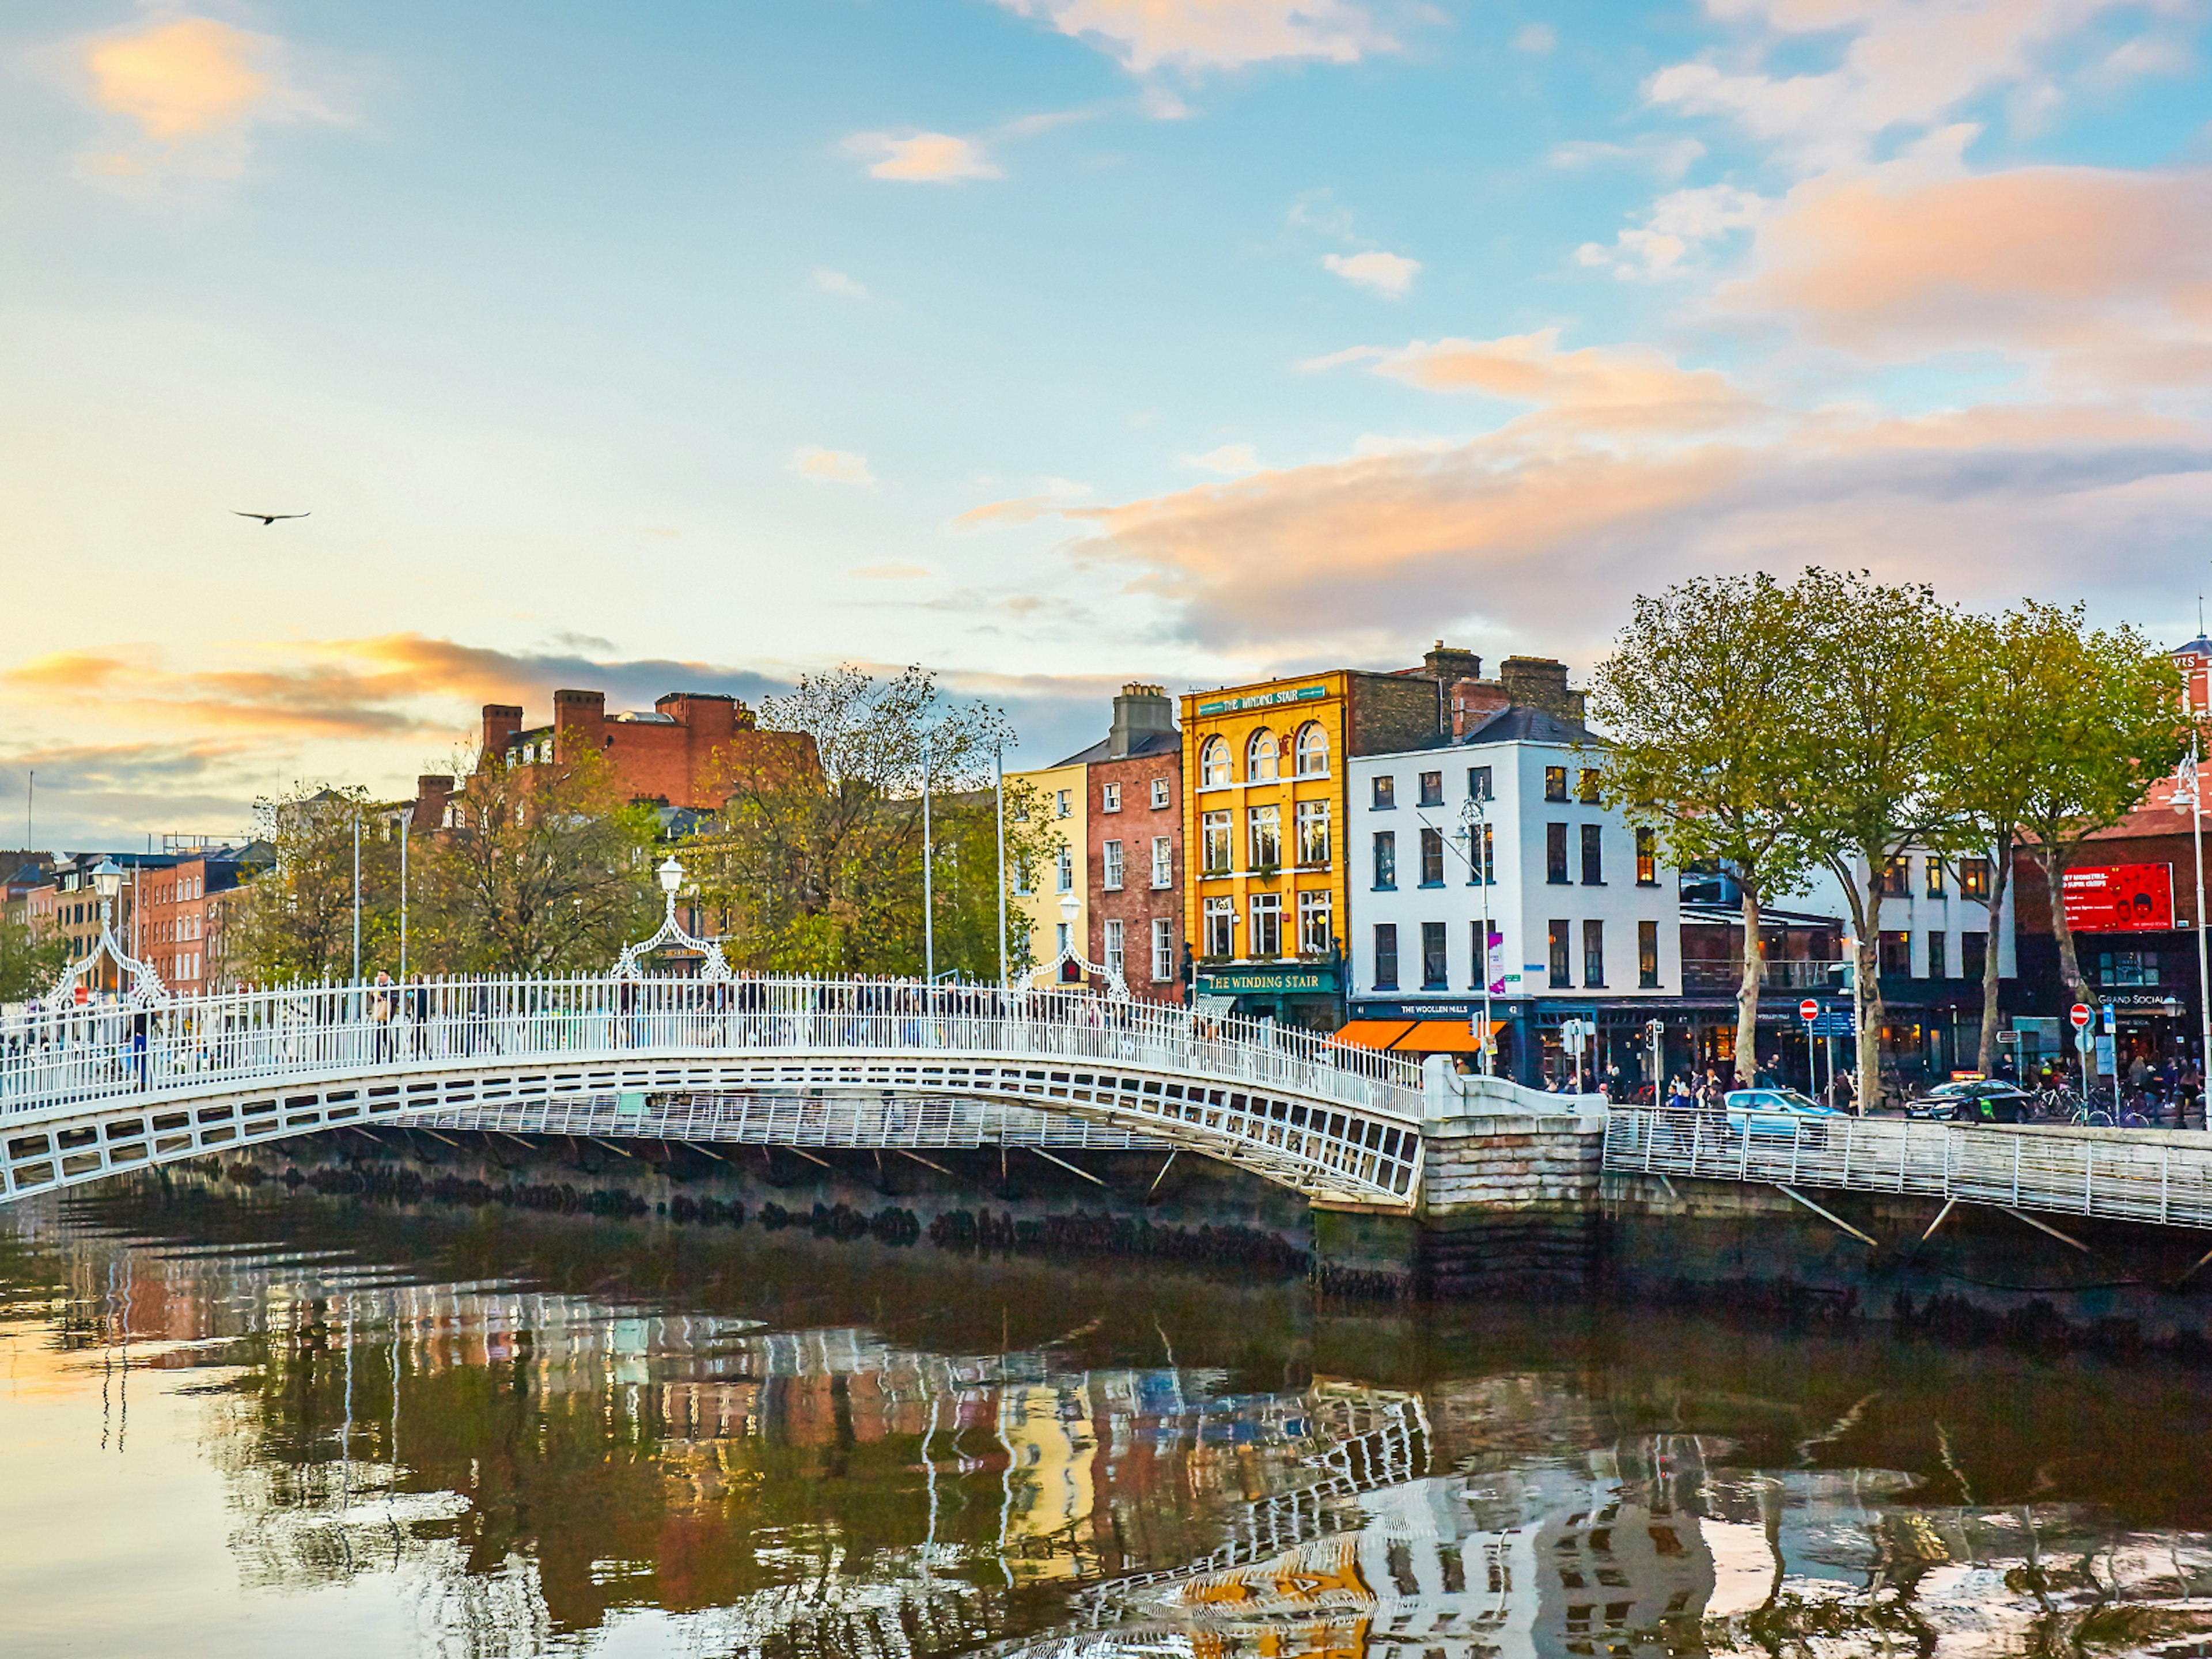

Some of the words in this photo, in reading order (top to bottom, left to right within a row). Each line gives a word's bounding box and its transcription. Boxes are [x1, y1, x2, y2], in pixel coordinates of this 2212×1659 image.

[1224, 699, 1238, 711] THE
[1242, 694, 1274, 709] WINDING
[1277, 690, 1298, 703] STAIR
[1209, 977, 1230, 989] THE
[1232, 975, 1283, 988] WINDING
[1285, 975, 1319, 987] STAIR
[2098, 994, 2131, 1005] GRAND
[2133, 994, 2163, 1005] SOCIAL
[1357, 1005, 1364, 1014] 41
[1401, 1005, 1415, 1014] THE
[1415, 1005, 1448, 1013] WOOLLEN
[1449, 1005, 1468, 1013] MILLS
